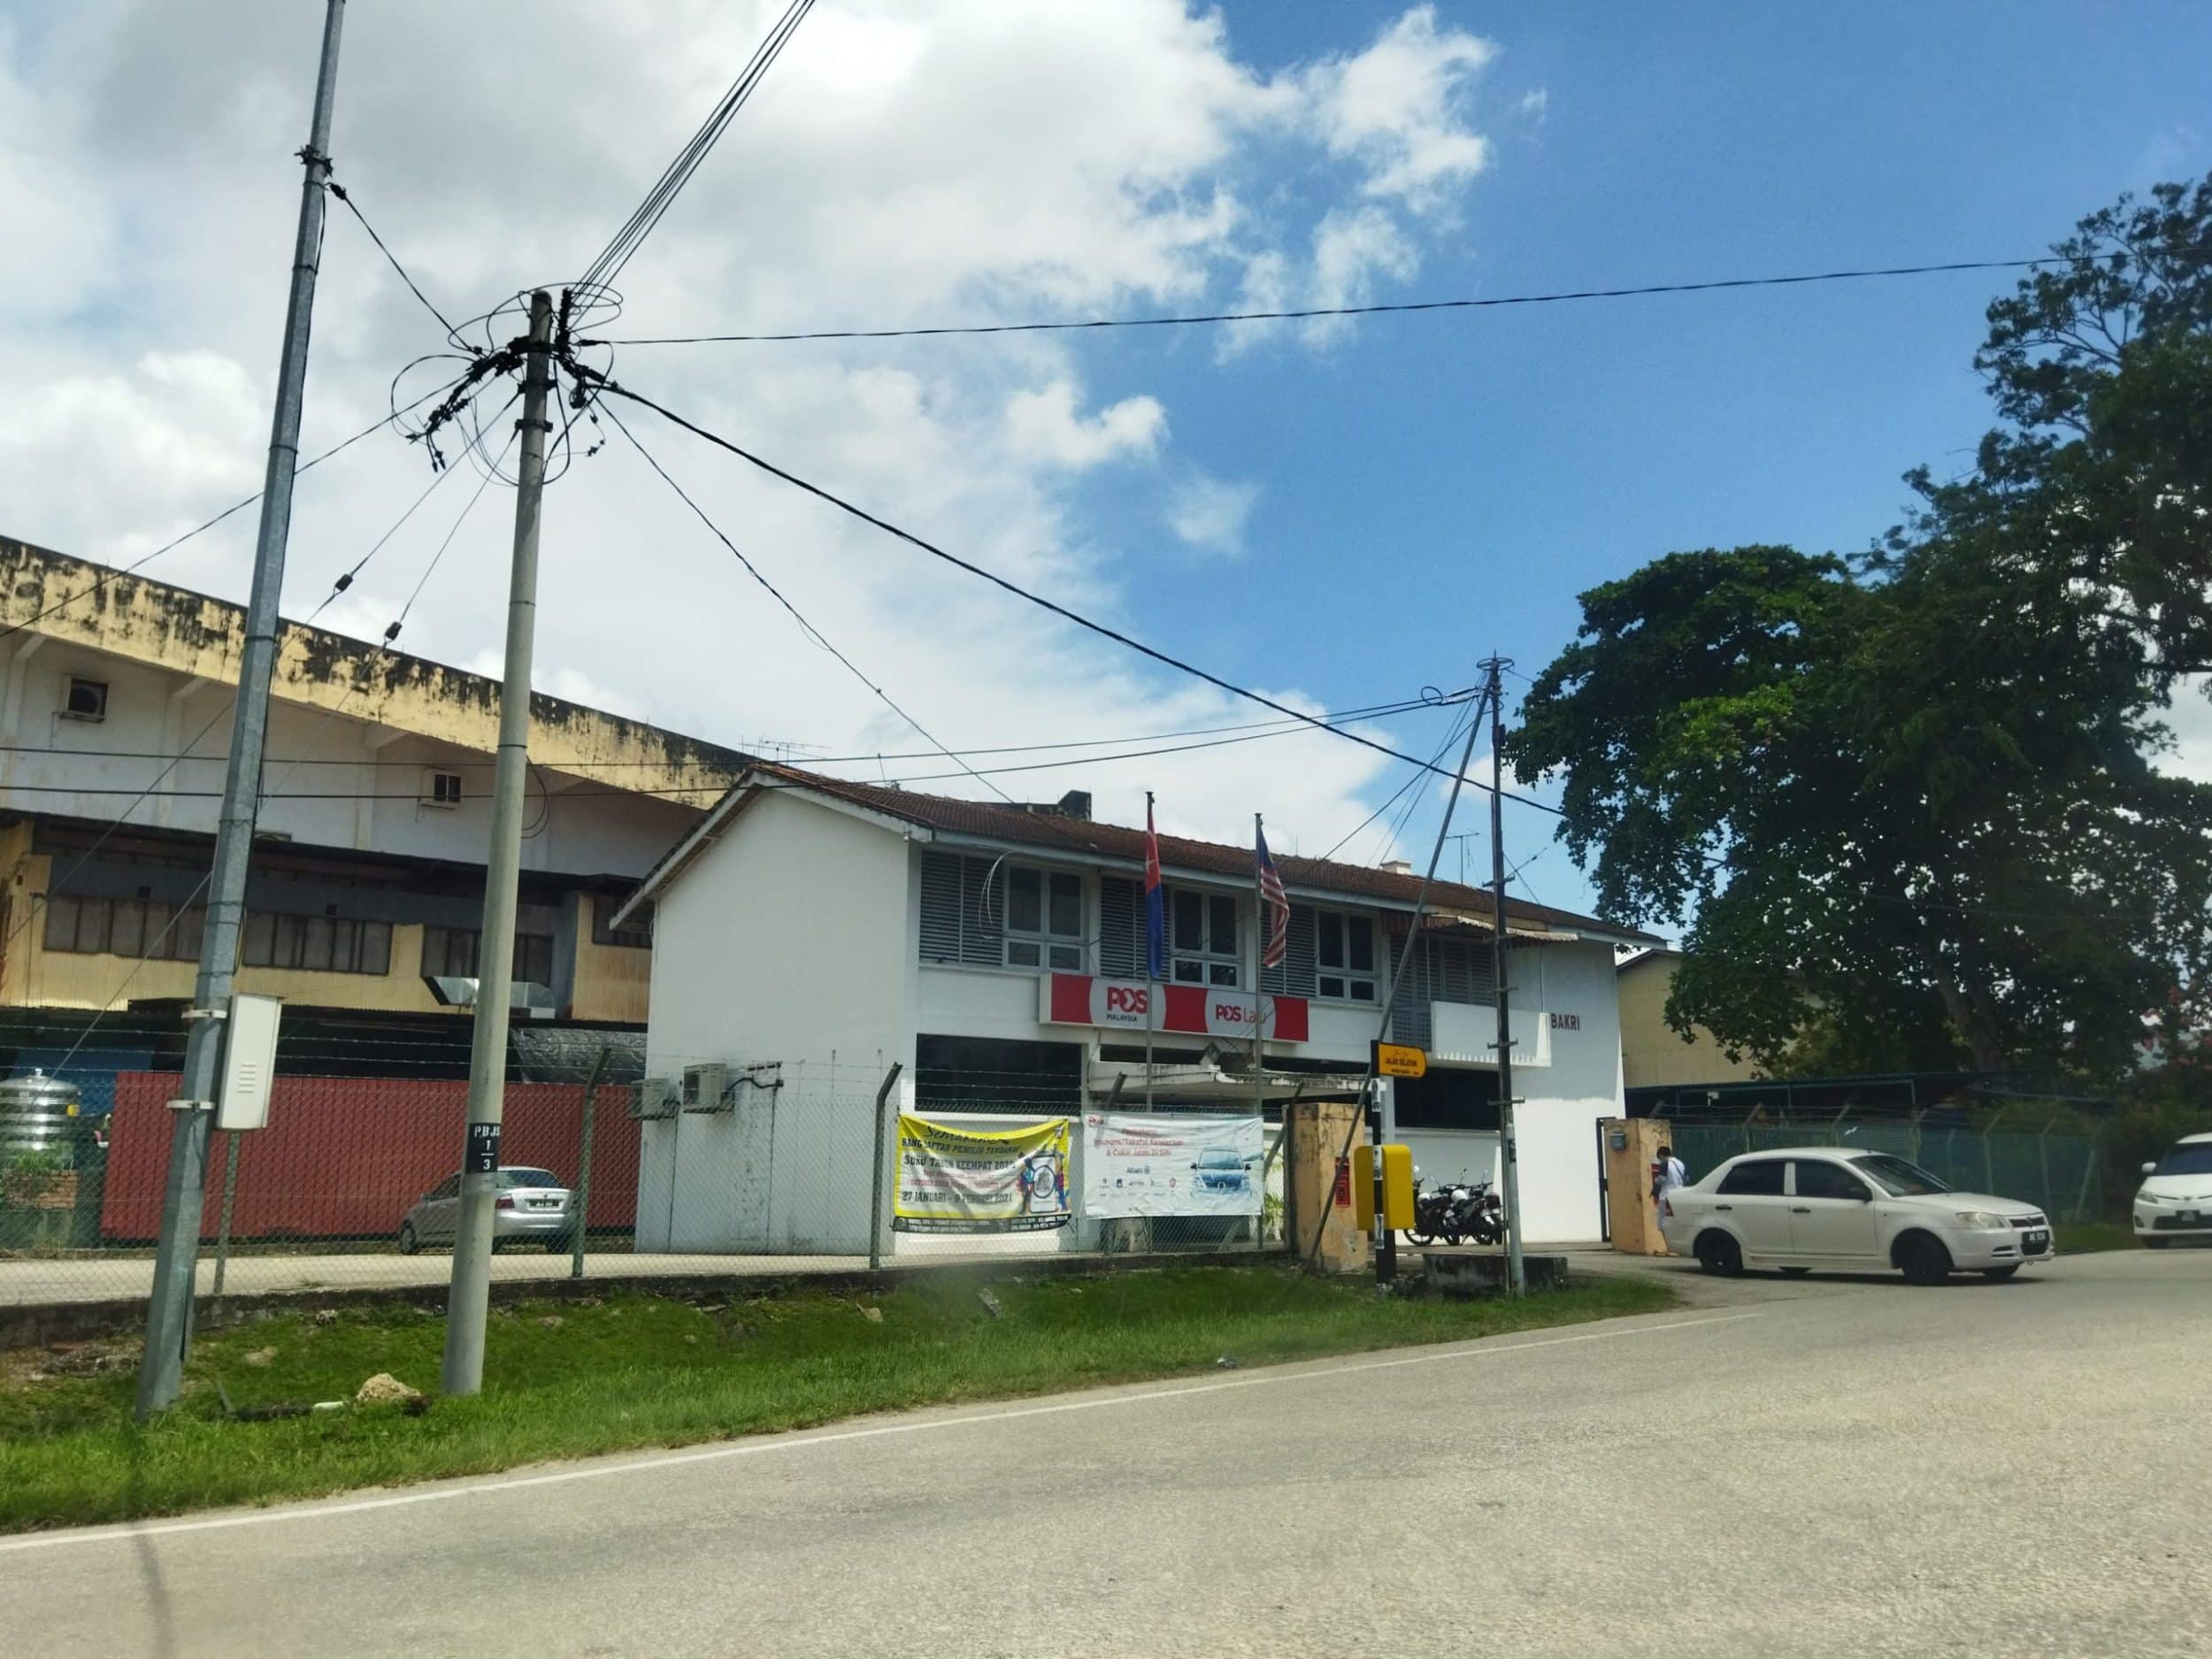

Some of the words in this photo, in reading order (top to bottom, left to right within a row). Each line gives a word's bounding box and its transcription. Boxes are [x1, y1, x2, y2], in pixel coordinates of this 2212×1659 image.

[1106, 986, 1148, 1015] POS
[1106, 1013, 1138, 1023] MALAYSIA
[1215, 1003, 1241, 1023] POS
[1243, 1007, 1266, 1024] Lau
[1550, 1013, 1580, 1031] BAKRI
[486, 1140, 491, 1151] 1
[482, 1159, 491, 1170] 3
[904, 1155, 926, 1166] SUKU
[956, 1160, 992, 1171] KEEMPAT
[902, 1191, 912, 1202] 27
[995, 1194, 1012, 1204] 2021
